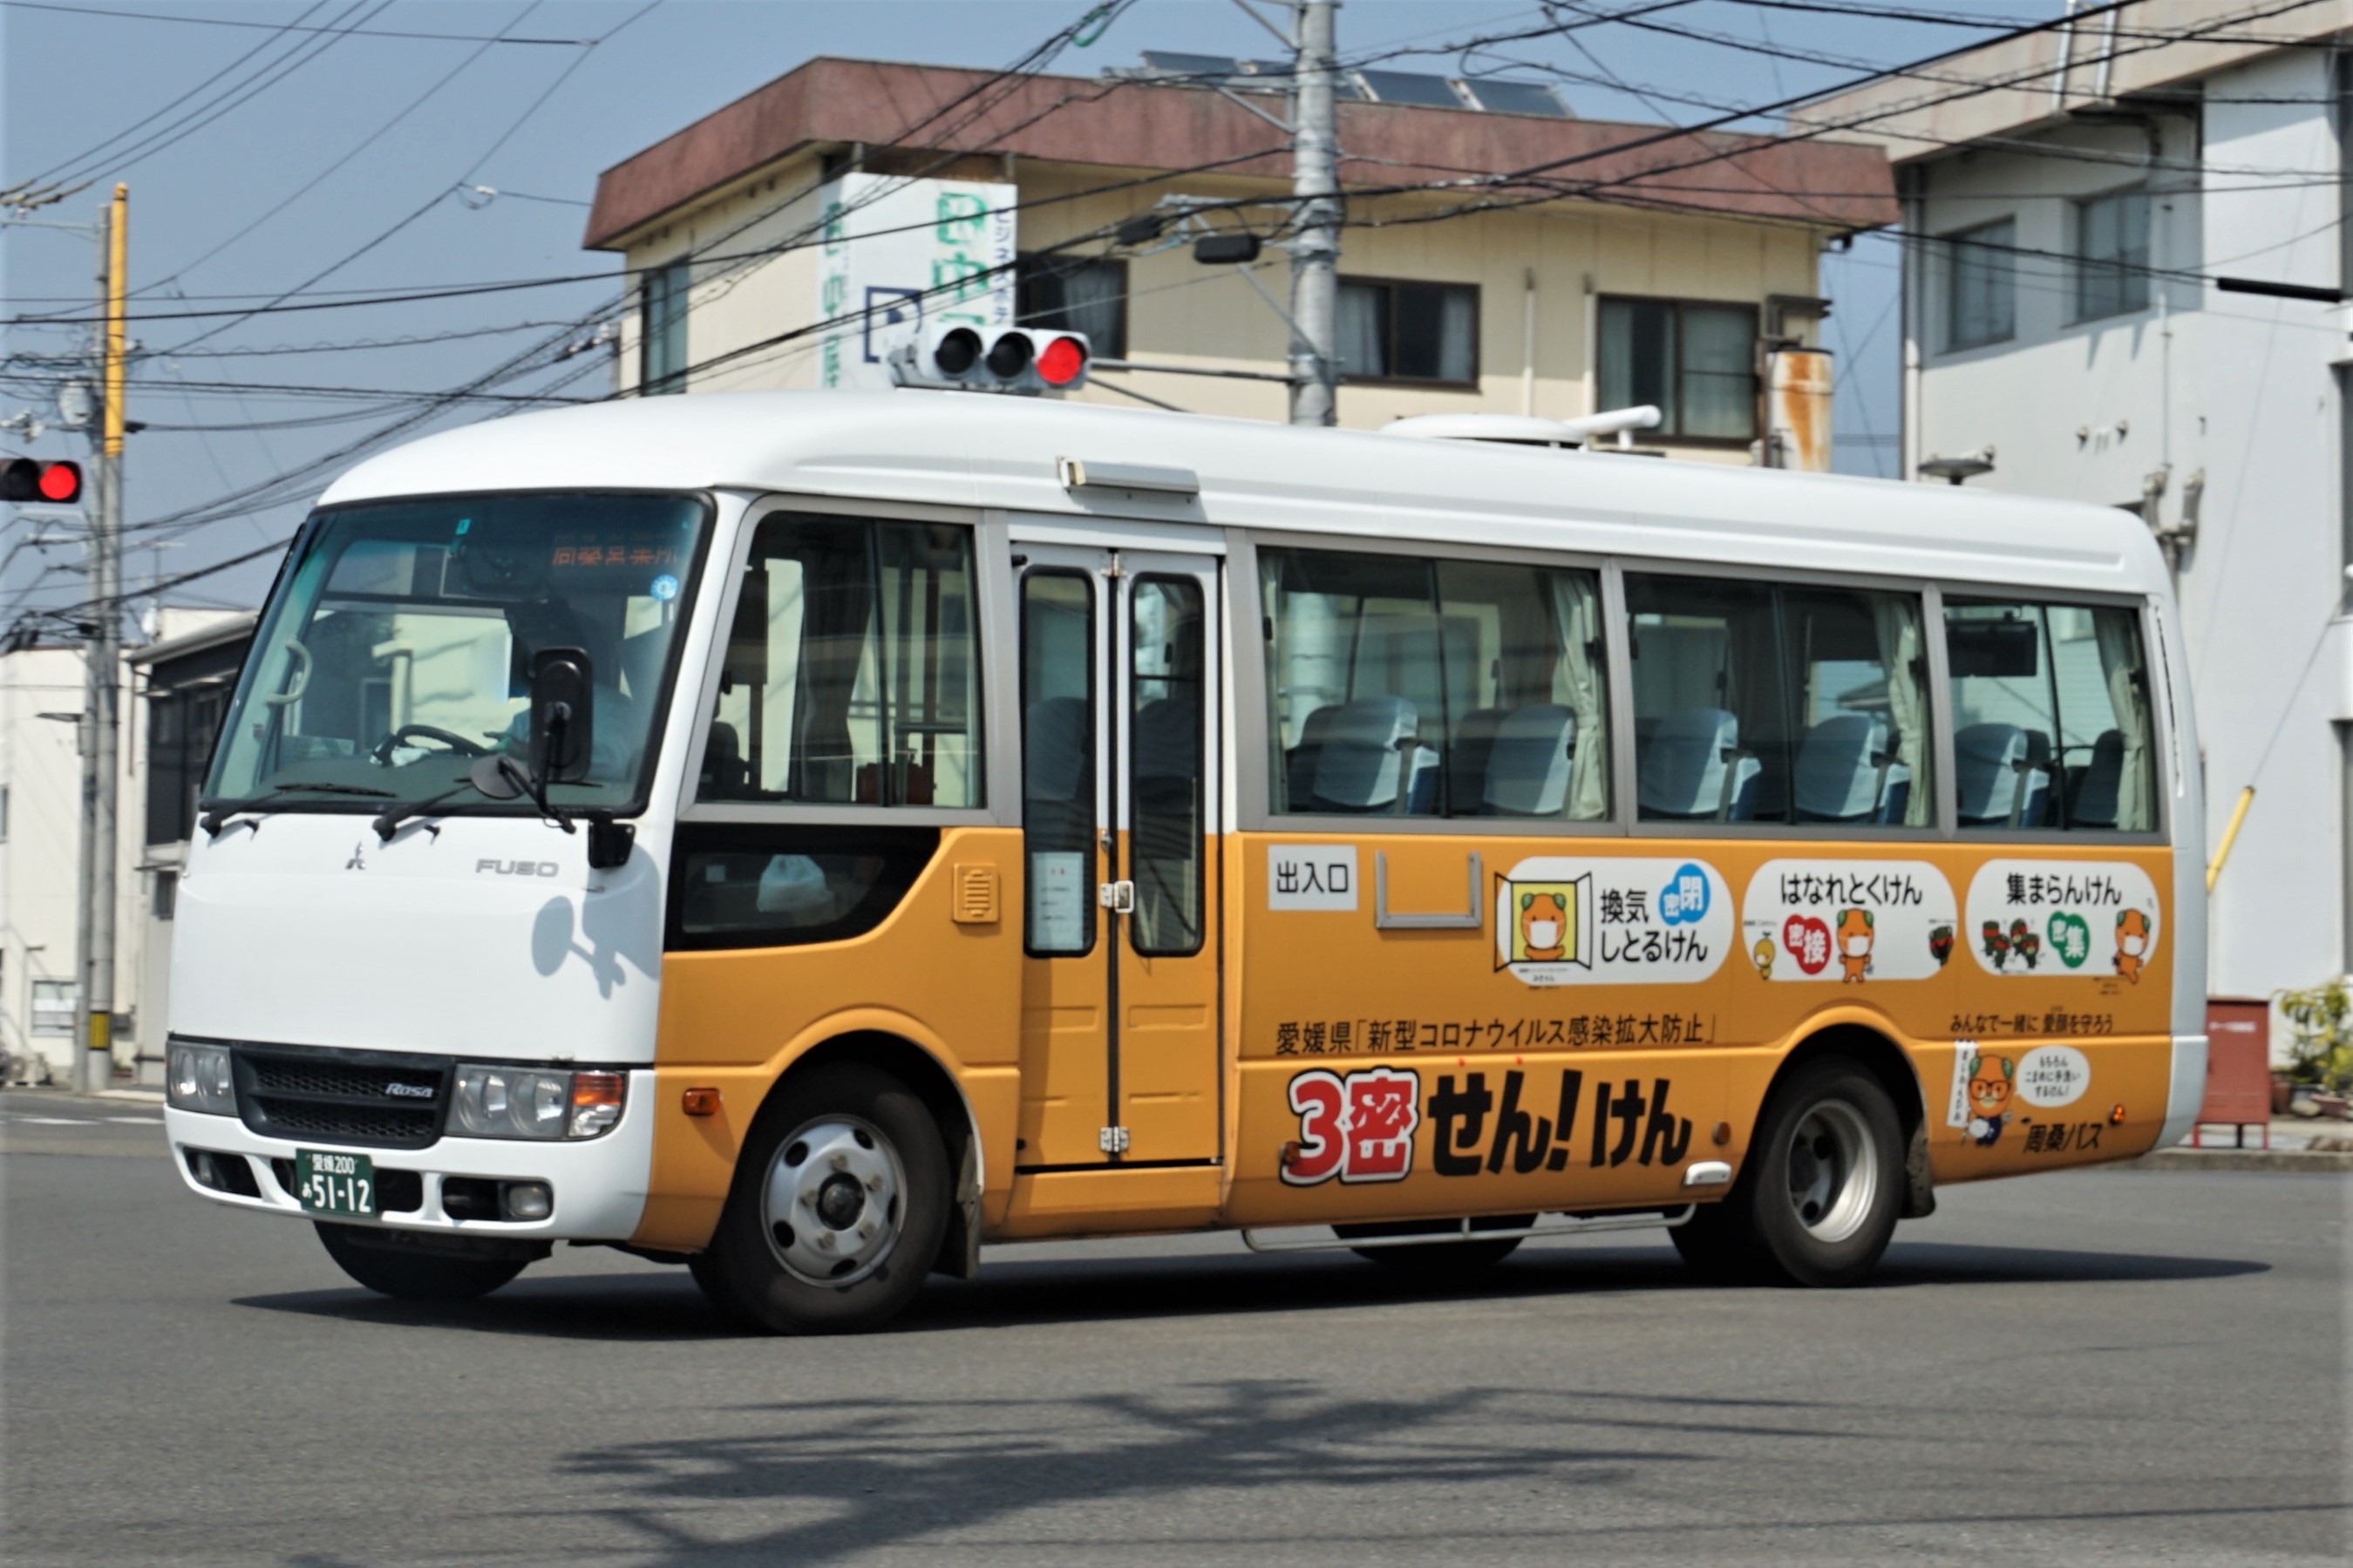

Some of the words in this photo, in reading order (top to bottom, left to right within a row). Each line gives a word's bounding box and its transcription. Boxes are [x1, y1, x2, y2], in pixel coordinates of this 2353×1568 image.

[475, 859, 560, 878] FUSO
[1275, 861, 1350, 895] 出入口
[1780, 872, 1923, 906] はなれとくけん
[2006, 872, 2123, 906] 集まらんけん
[1599, 889, 1649, 925] 換気
[1600, 929, 1709, 963] しとるけん
[1275, 1013, 1717, 1056] 愛媛県「新型コロナウイルス感染拡大防止」
[385, 1083, 433, 1098] Rosa
[2023, 1123, 2104, 1154] 周桑バス
[312, 1174, 371, 1213] 51-12
